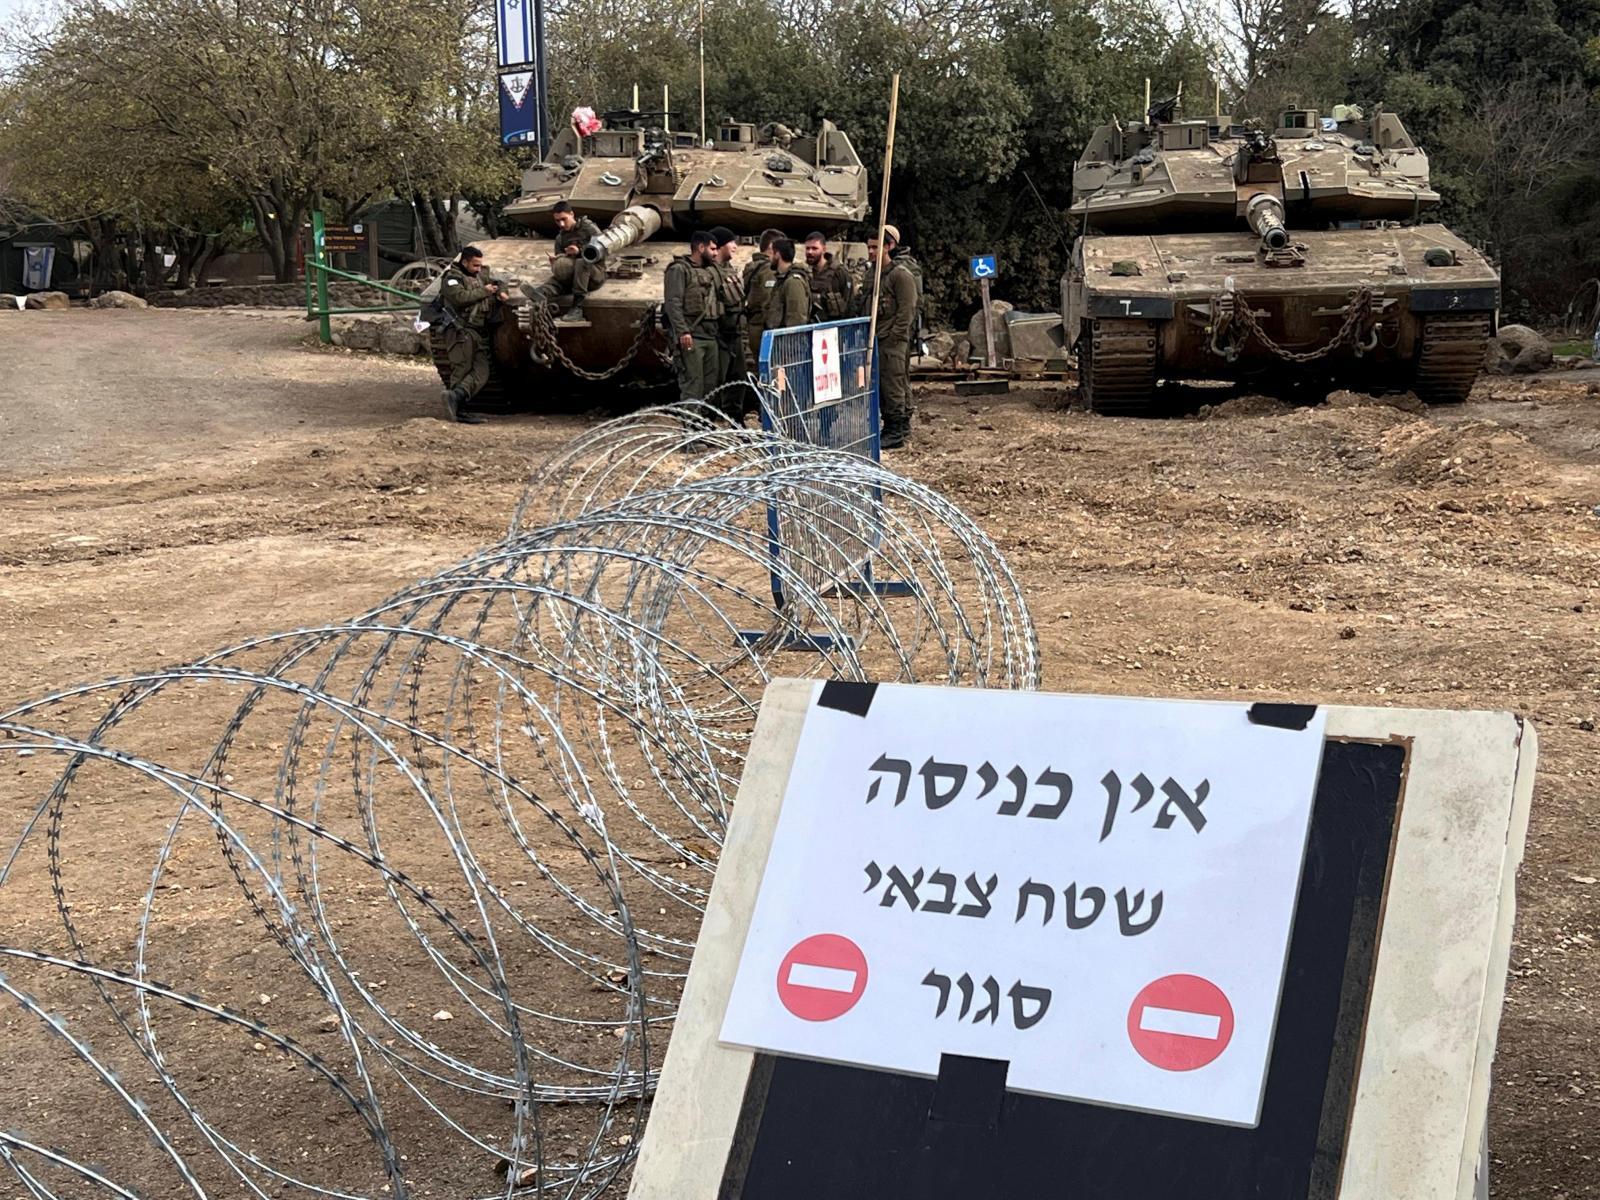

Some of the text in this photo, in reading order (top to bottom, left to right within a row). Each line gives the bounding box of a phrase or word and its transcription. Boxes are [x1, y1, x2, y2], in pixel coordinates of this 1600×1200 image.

[865, 752, 1210, 843] אין כניסה
[863, 860, 1164, 937] שטח צבאי
[921, 968, 1053, 1030] סגור
